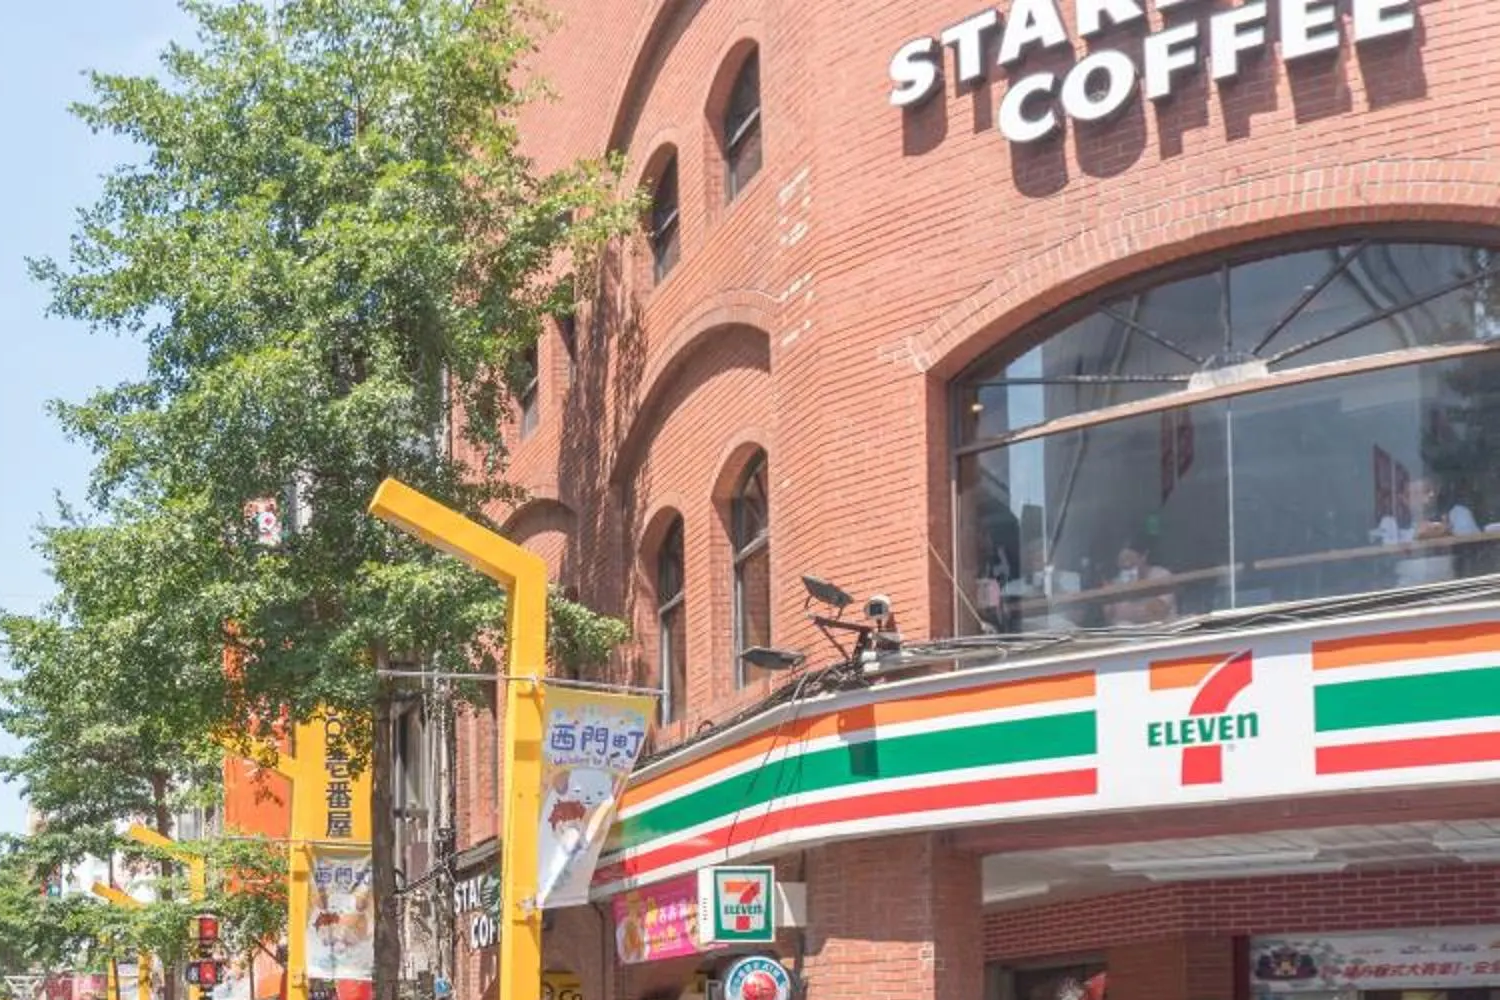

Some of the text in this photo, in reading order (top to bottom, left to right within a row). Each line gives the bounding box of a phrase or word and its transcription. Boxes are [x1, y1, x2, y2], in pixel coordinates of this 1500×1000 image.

[889, 0, 1192, 105] STA
[998, 0, 1415, 142] COFFEE
[550, 723, 644, 759] 西門町
[1148, 648, 1253, 786] 7
[723, 880, 761, 931] 7
